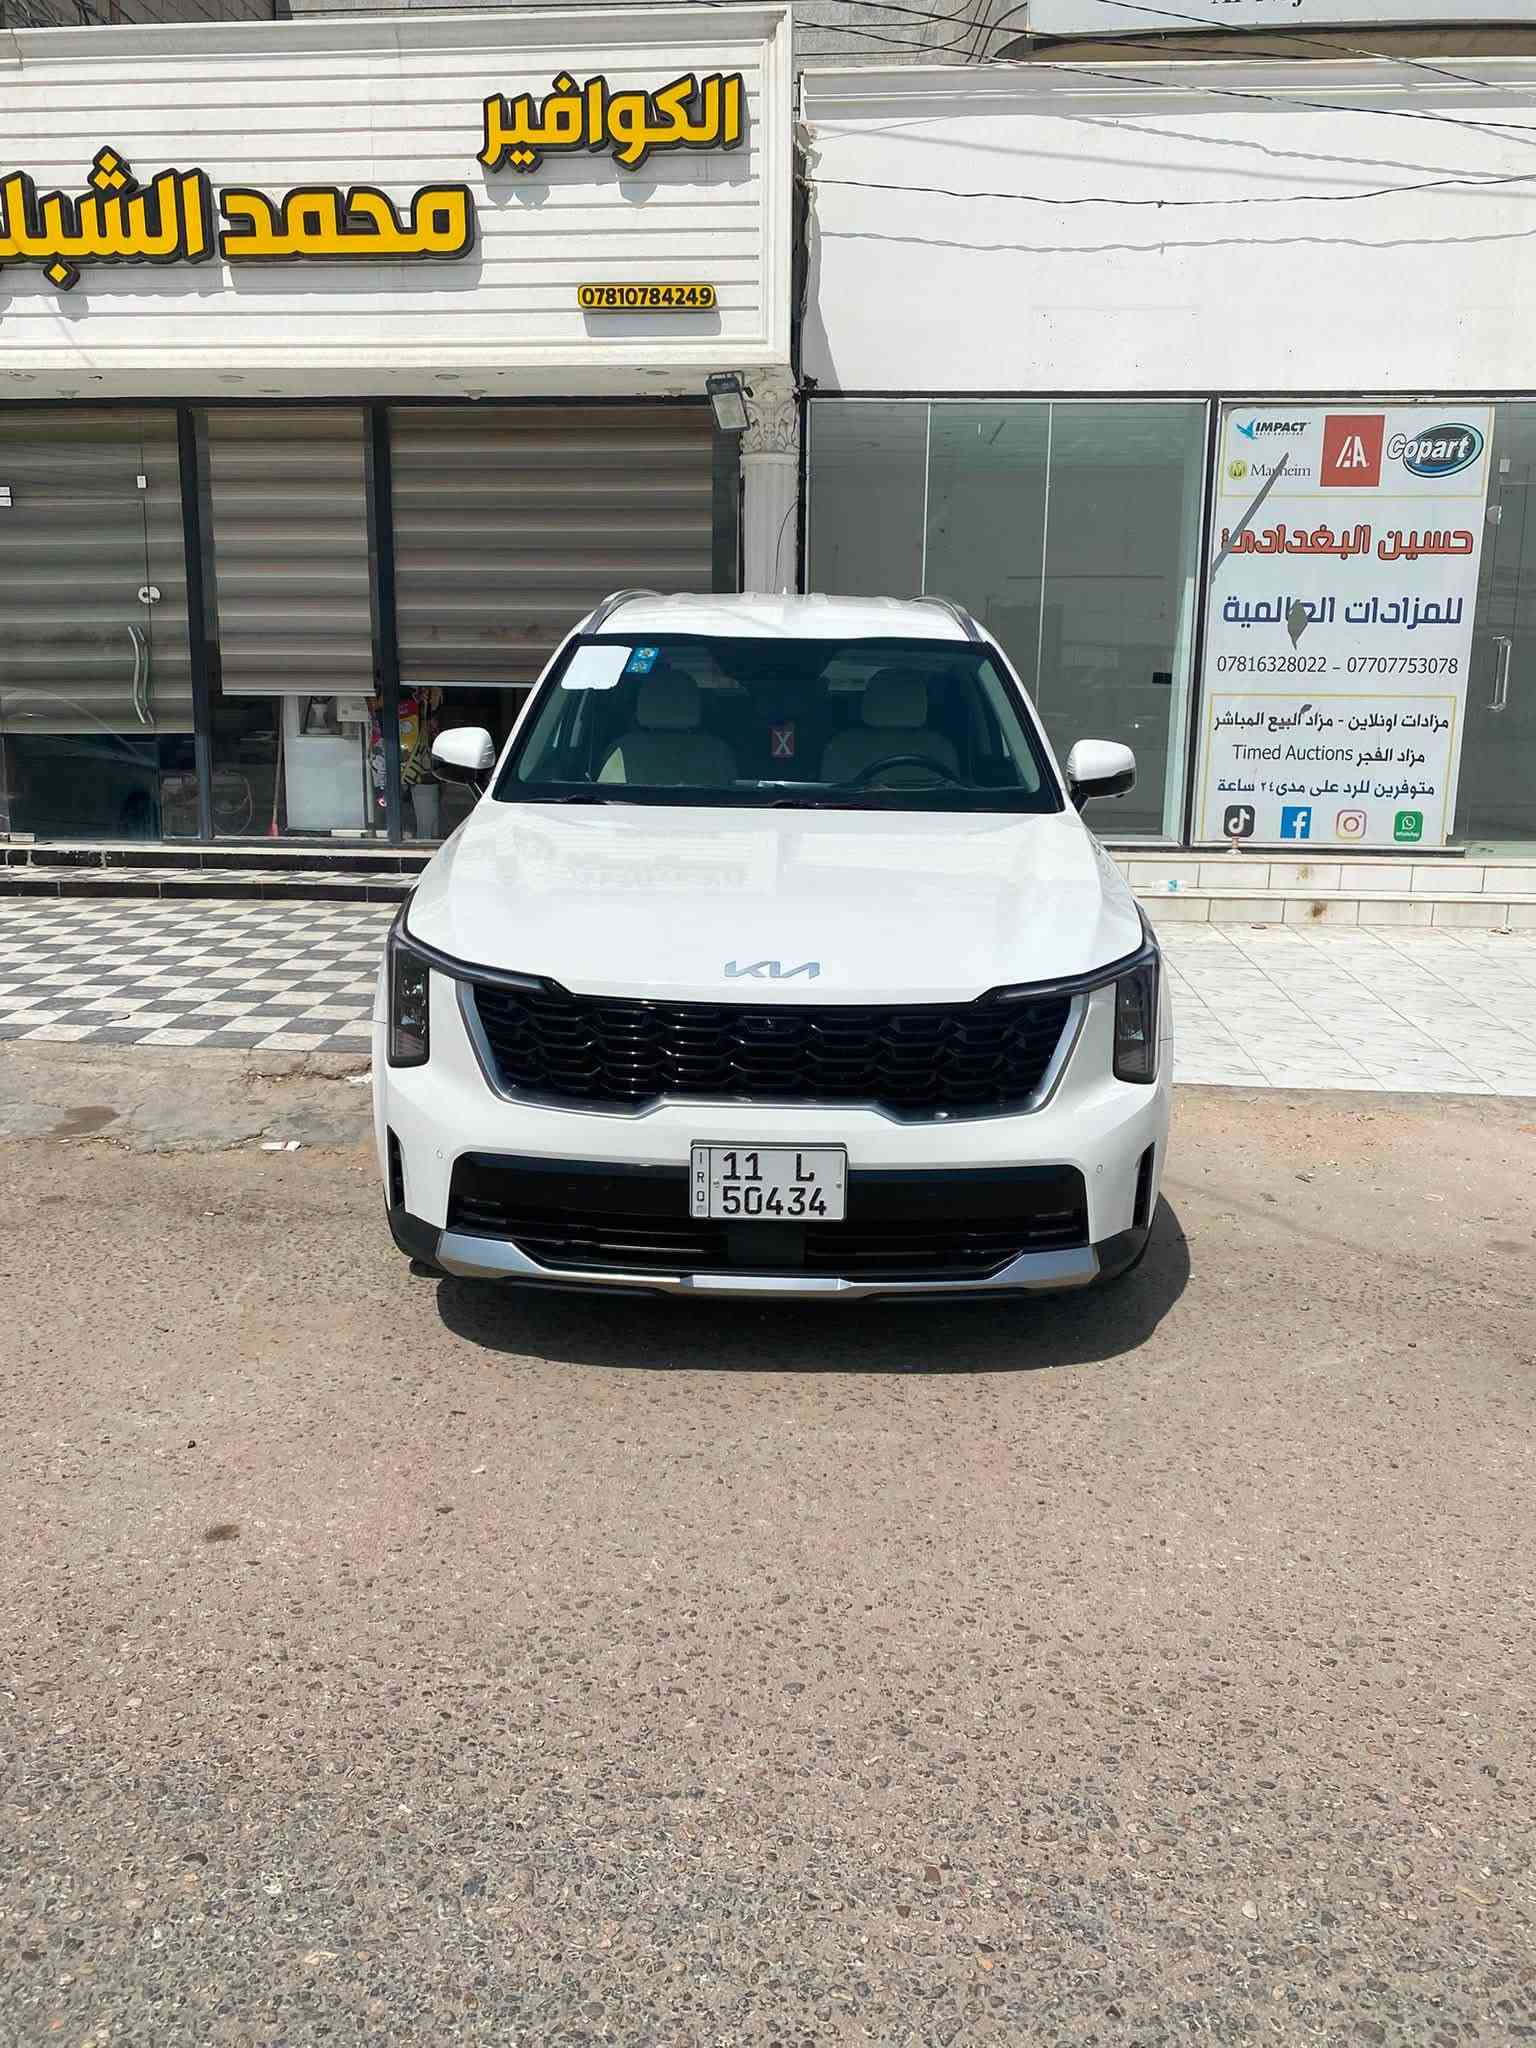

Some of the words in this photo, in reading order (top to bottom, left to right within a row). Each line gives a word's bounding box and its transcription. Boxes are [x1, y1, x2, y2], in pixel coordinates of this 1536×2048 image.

[476, 72, 746, 173] الكوافير
[0, 145, 214, 291] الشبل
[219, 183, 476, 262] محمد
[582, 287, 712, 305] 07810784249
[1256, 421, 1306, 432] IMPACT
[1386, 432, 1471, 465] Copart
[1250, 463, 1311, 477] Maheim
[1377, 530, 1474, 560] حسين
[1345, 597, 1463, 629] للمزادات
[1217, 655, 1327, 673] 07816328022
[1347, 656, 1459, 674] 07707753078
[1214, 710, 1265, 731] المباشر
[1267, 711, 1304, 732] البيع
[1305, 711, 1334, 732] مزاد
[1348, 713, 1398, 733] اونلاين
[1401, 713, 1449, 733] مزادات
[1232, 744, 1281, 760] Timed
[1285, 744, 1354, 761] Auctions
[1356, 747, 1393, 767] الفجر
[1397, 748, 1425, 767] مزاد
[1217, 779, 1255, 792] ساعة
[1309, 780, 1339, 797] على
[1343, 780, 1370, 799] للرد
[1374, 779, 1435, 800] متوفرين
[724, 960, 820, 980] KIA
[722, 1152, 763, 1181] 11
[722, 1186, 827, 1216] 50434
